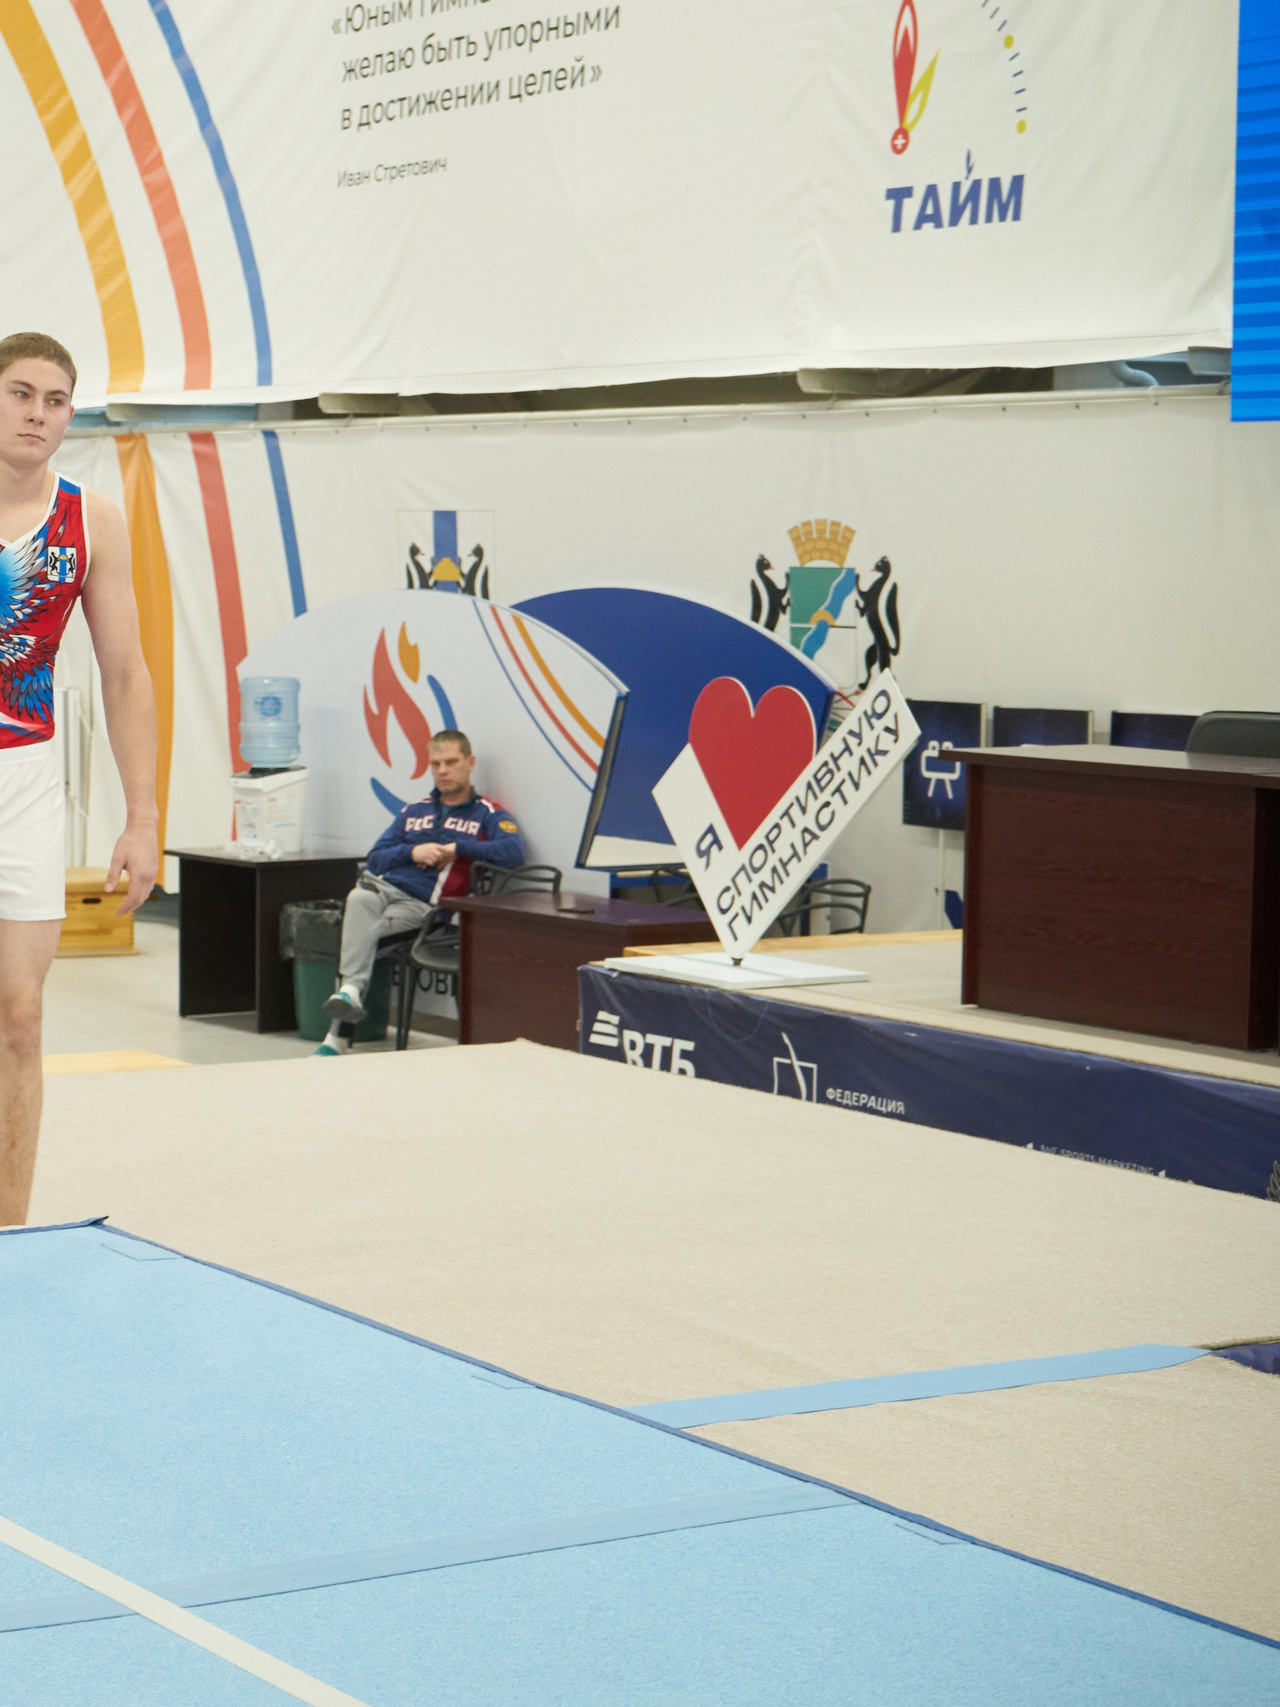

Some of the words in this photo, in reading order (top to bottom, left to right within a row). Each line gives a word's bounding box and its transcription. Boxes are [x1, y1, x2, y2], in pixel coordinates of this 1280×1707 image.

[342, 47, 415, 83] желаю
[422, 32, 478, 65] быть
[483, 5, 620, 61] упорными
[341, 108, 352, 130] в
[357, 80, 500, 131] достижении
[337, 169, 371, 188] Иван
[373, 157, 448, 185] Стретович
[885, 149, 1025, 233] ТАЙМ
[716, 689, 891, 915] СПОРТИВНУЮ
[695, 823, 723, 871] Я
[727, 713, 899, 941] ГИМНАСТИКУ
[623, 1030, 696, 1078] ВТБ
[826, 1087, 906, 1115] ФЕДЕРАЦИЯ
[1098, 1156, 1155, 1175] MARKETING
